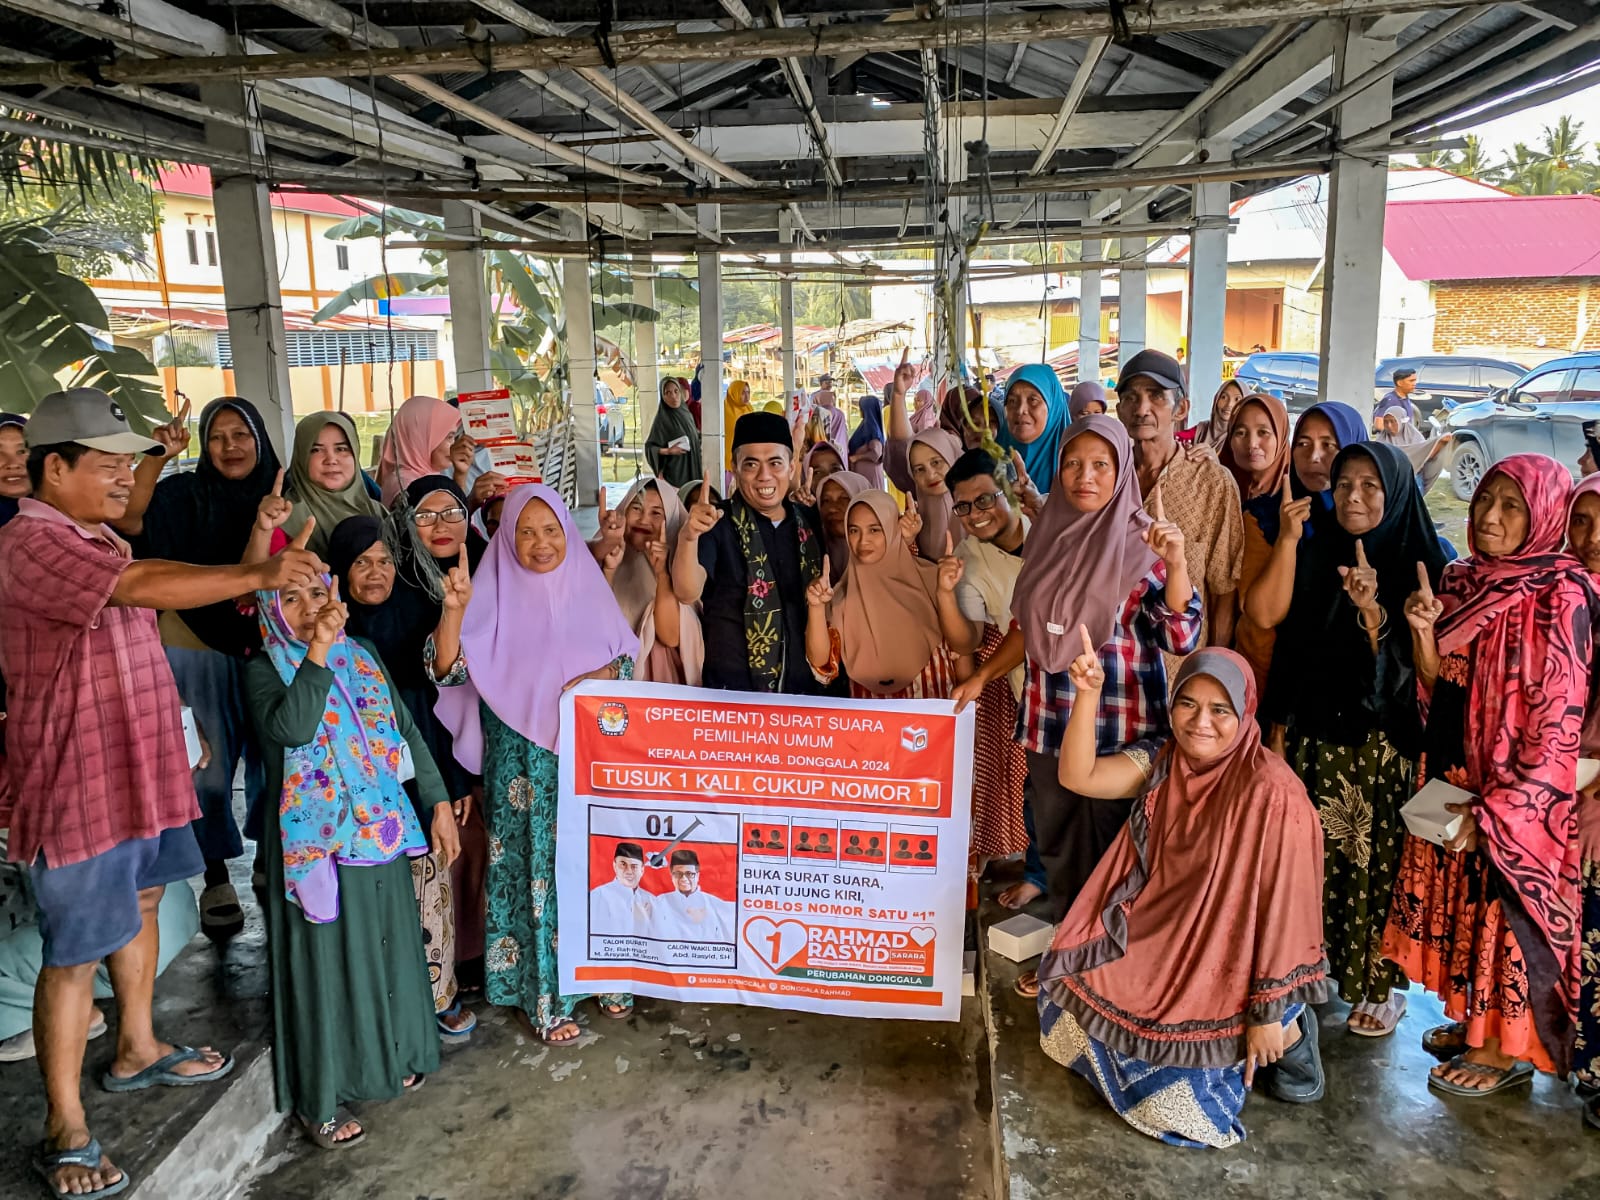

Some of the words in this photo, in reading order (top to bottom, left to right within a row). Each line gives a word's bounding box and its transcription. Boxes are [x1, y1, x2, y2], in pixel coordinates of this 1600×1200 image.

[645, 706, 764, 728] (SPECIEMENT)
[769, 713, 824, 729] SURAT
[828, 717, 885, 733] SUARA
[693, 728, 779, 745] PEMILIHAN
[784, 734, 833, 748] UMUM
[648, 748, 696, 760] KEPALA
[700, 750, 752, 763] DAERAH
[755, 753, 783, 765] KAB.
[787, 755, 858, 769] DONGGALA
[861, 761, 890, 771] 2024
[602, 768, 672, 787] TUSUK
[680, 772, 688, 789] 1
[696, 773, 745, 791] KALI.
[752, 776, 825, 796] CUKUP
[831, 781, 911, 801] NOMOR
[919, 787, 928, 803] 1
[645, 814, 677, 838] 01
[743, 868, 781, 881] BUKA
[784, 871, 829, 884] SURAT
[832, 875, 884, 891] SUARA,
[743, 884, 780, 896] LIHAT
[784, 887, 831, 900] UJUNG
[834, 890, 865, 904] KIRI,
[743, 899, 803, 912] COBLOS
[808, 904, 863, 917] NOMOR
[868, 909, 908, 921] SATU
[766, 932, 783, 964] 1
[808, 927, 909, 949] RAHMAD
[807, 942, 890, 963] RASYID
[806, 969, 866, 981] PERUBAHAN
[868, 974, 923, 985] DONGGALA
